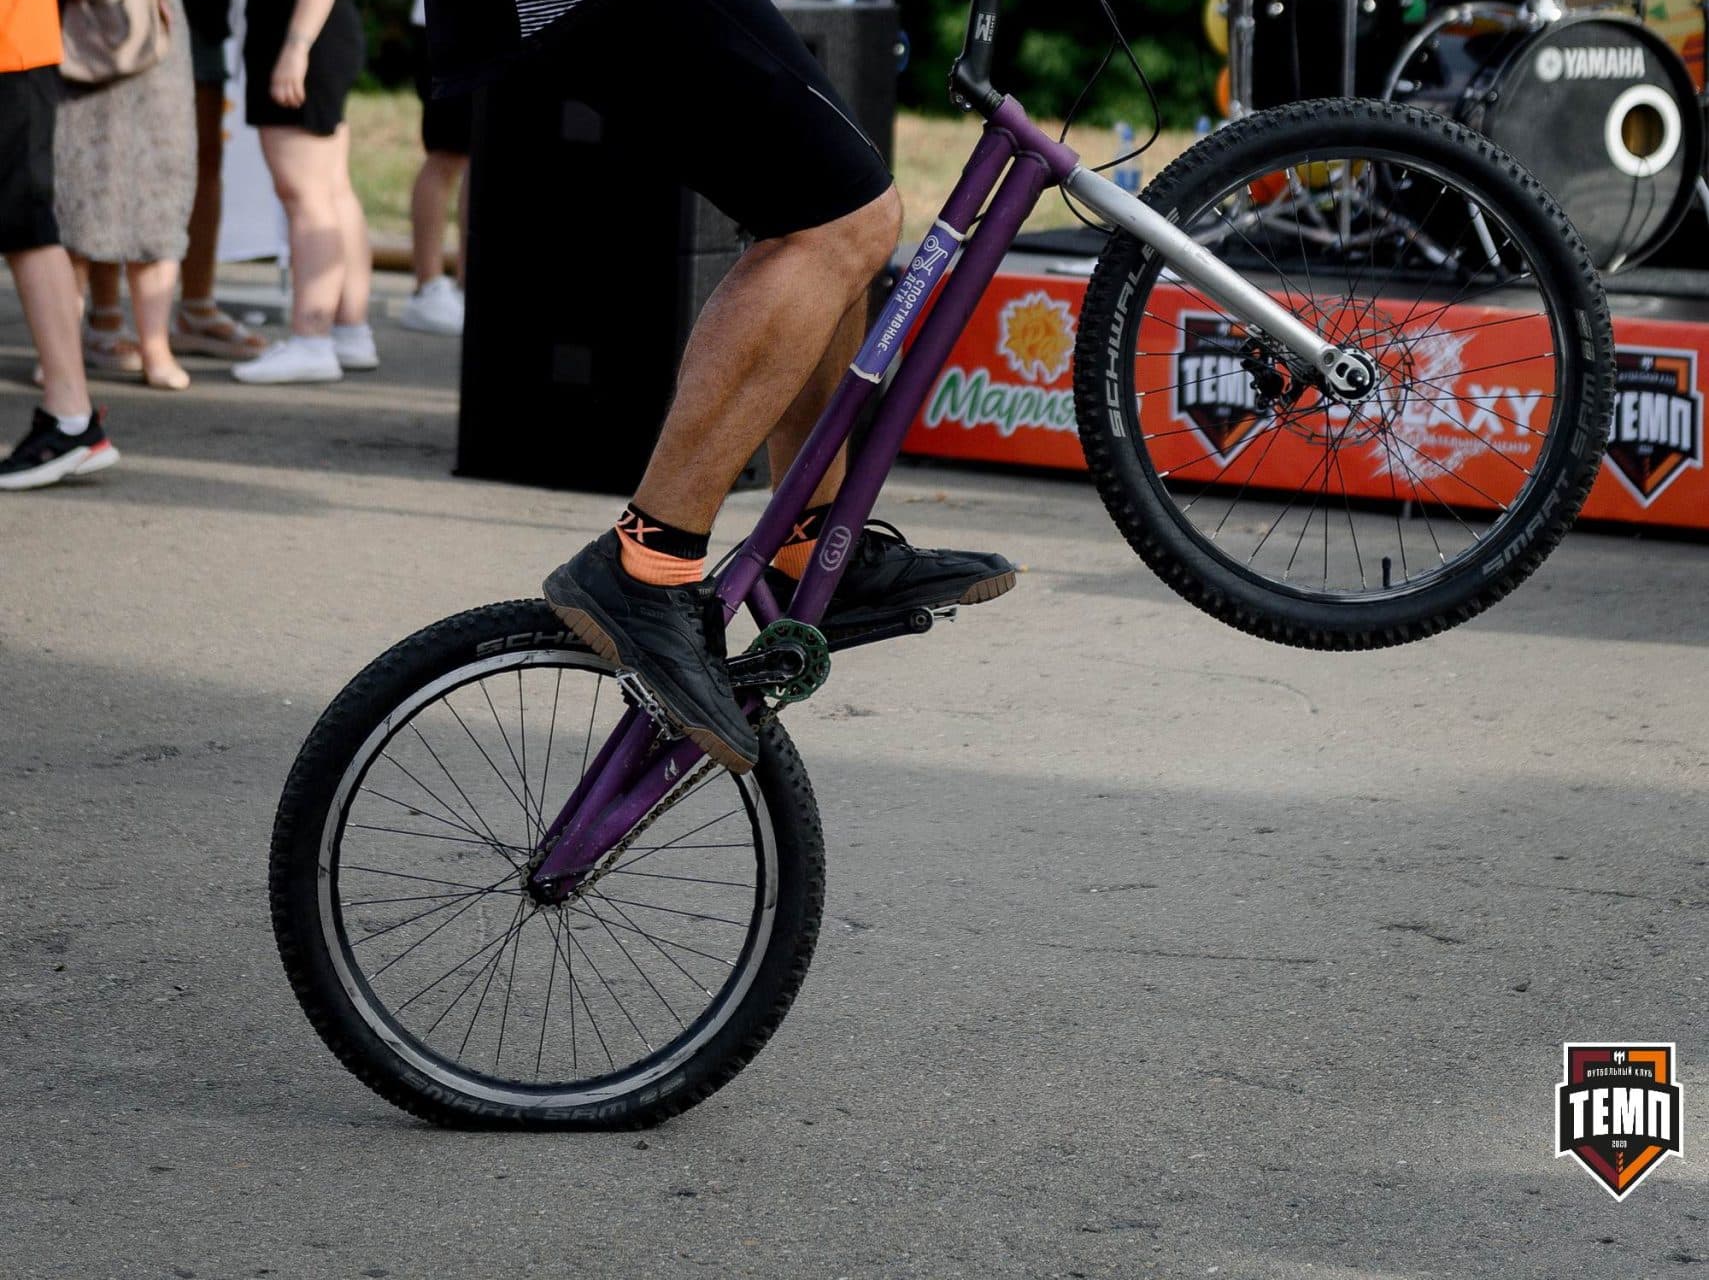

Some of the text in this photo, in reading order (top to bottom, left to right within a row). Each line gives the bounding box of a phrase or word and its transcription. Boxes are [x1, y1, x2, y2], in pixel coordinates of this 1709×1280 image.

[1563, 46, 1645, 79] YAMAHA
[895, 272, 914, 303] ДЕТИ
[877, 279, 926, 352] СПОРТИВНЫЕ
[1482, 469, 1570, 576] SMART
[1571, 372, 1600, 458] SAM
